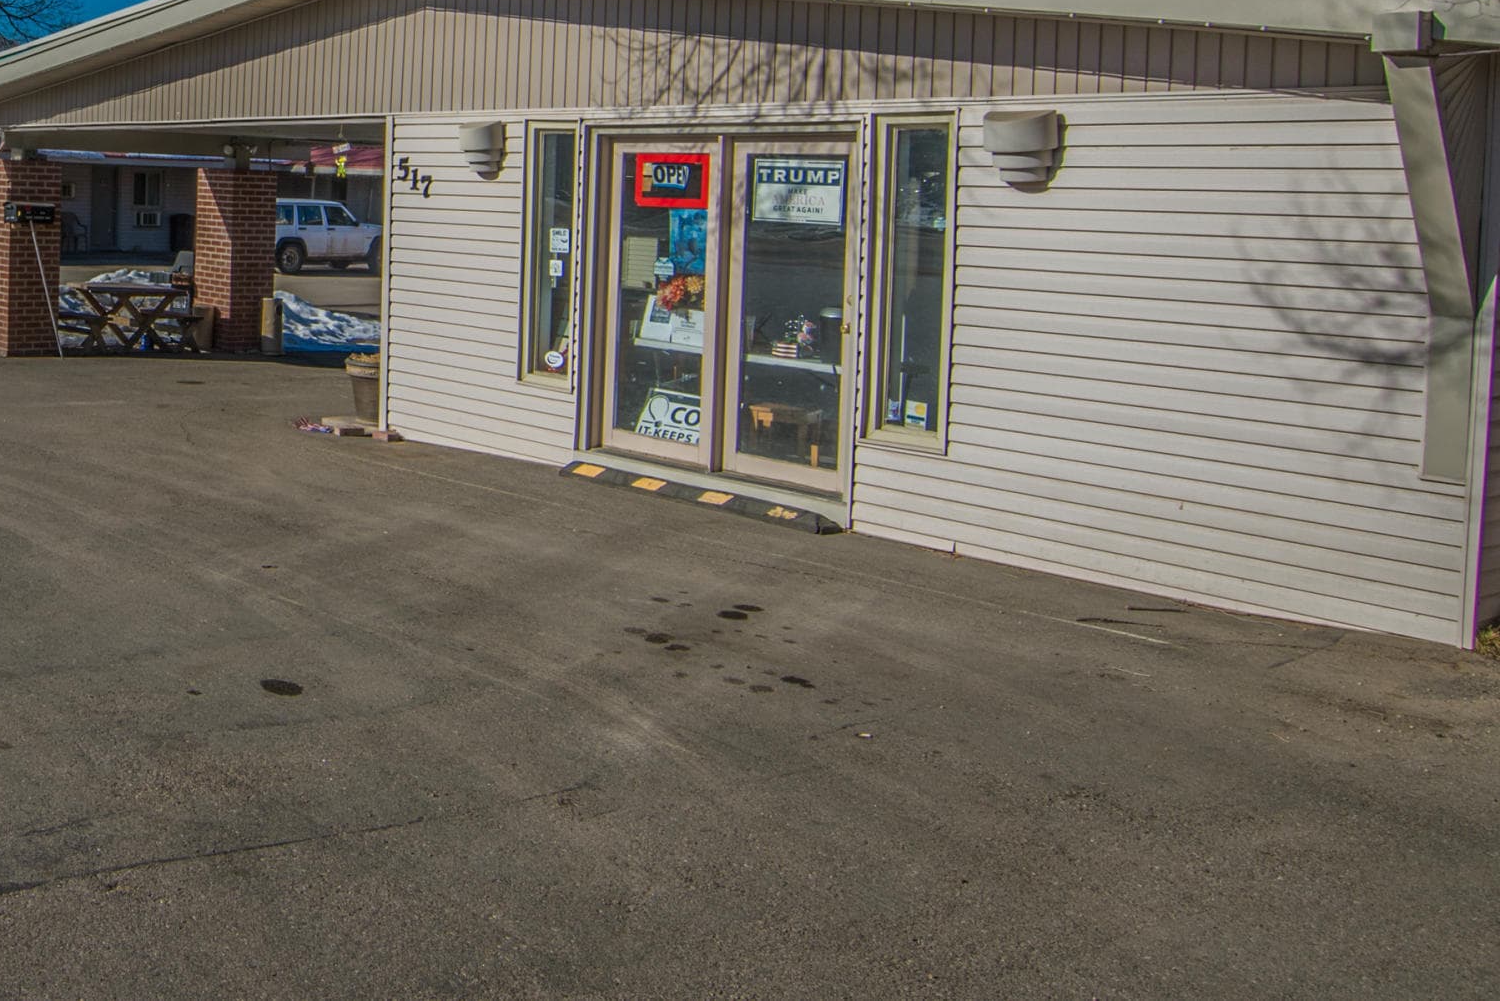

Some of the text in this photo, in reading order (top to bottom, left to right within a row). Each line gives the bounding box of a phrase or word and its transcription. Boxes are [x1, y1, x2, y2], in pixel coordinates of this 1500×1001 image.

[397, 156, 432, 198] 517
[653, 165, 688, 185] OPEN
[759, 168, 840, 184] TRUMP
[797, 206, 823, 214] AGAIN!
